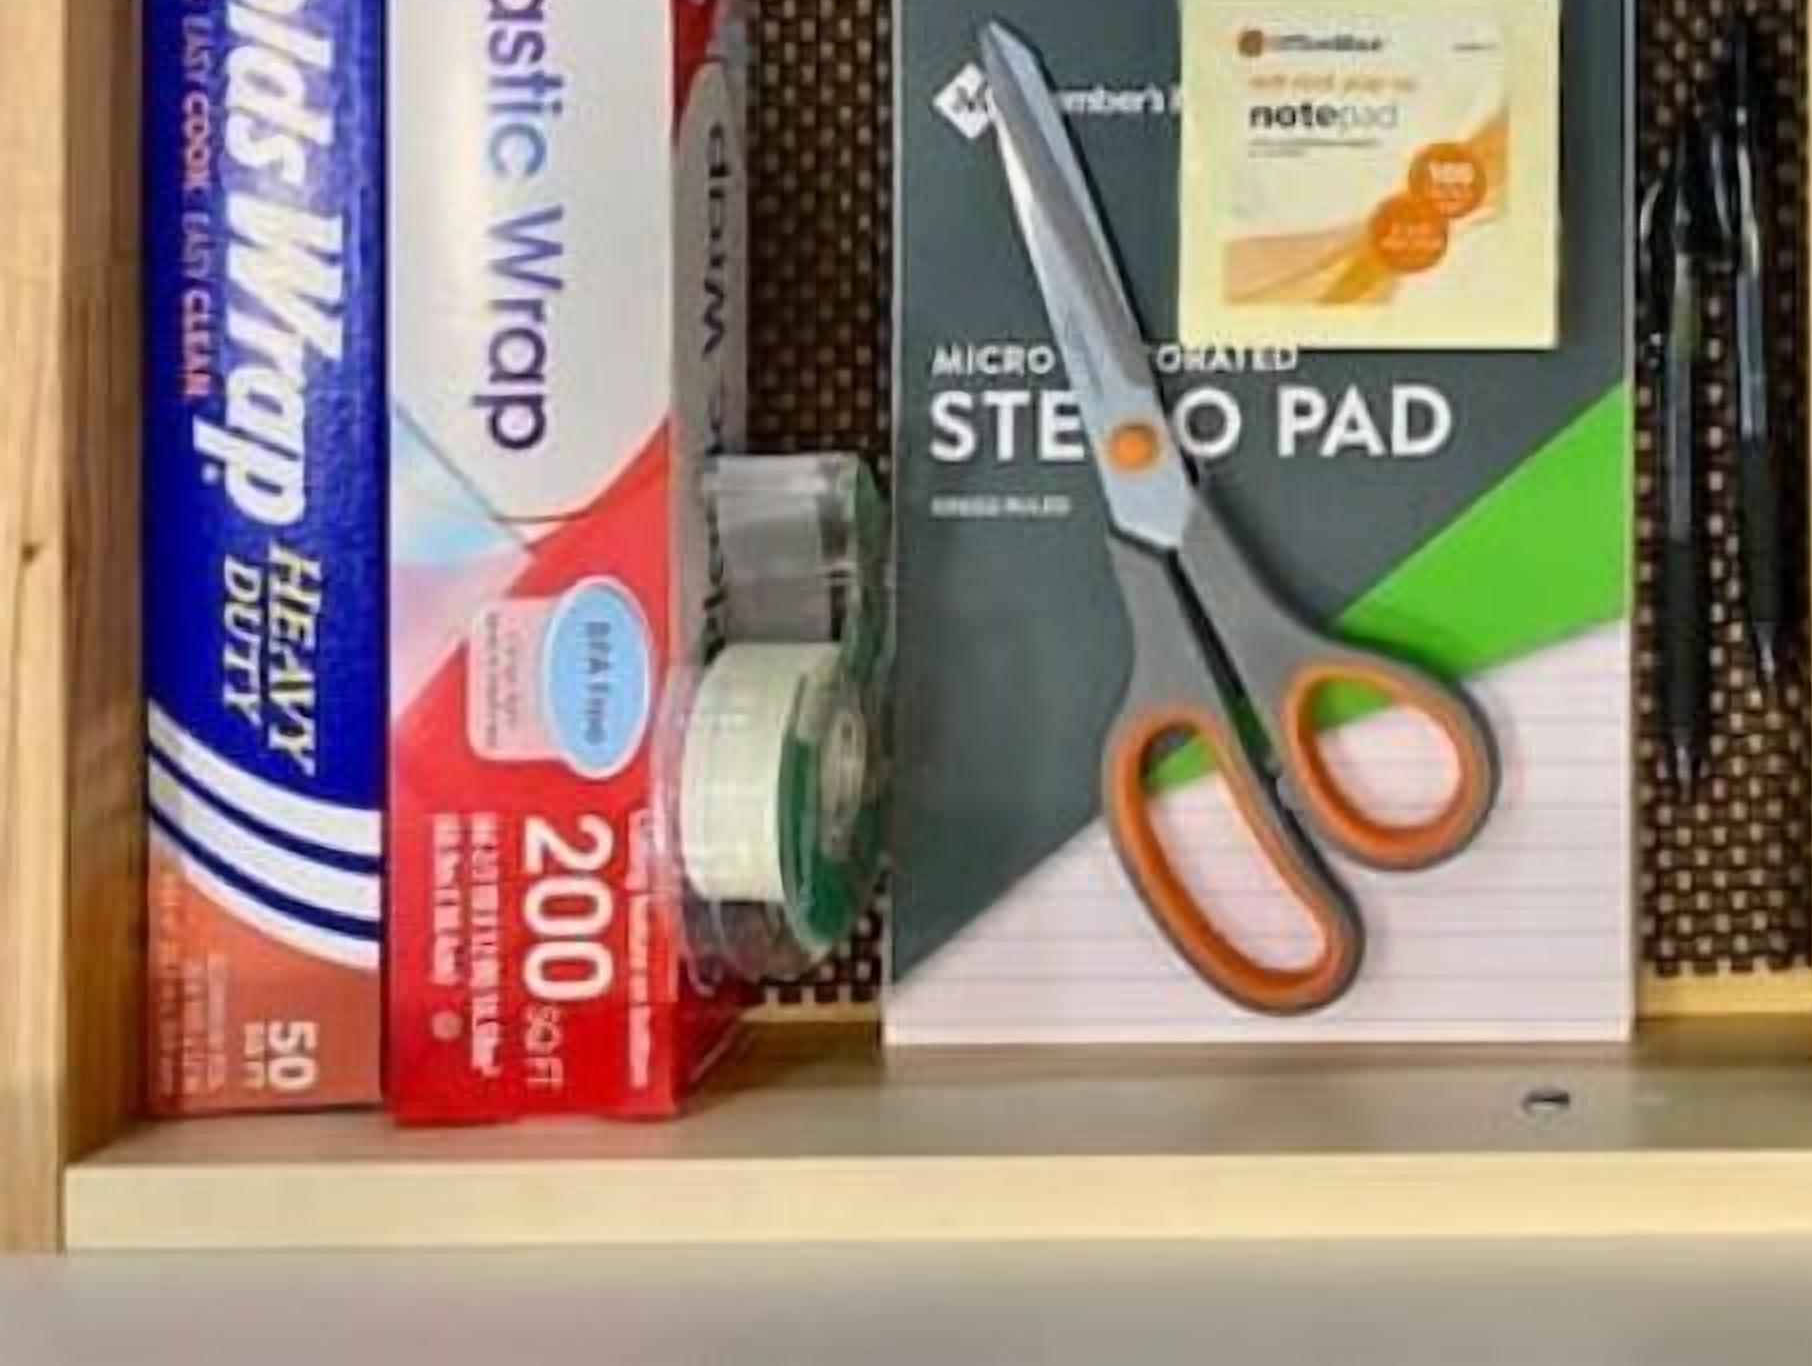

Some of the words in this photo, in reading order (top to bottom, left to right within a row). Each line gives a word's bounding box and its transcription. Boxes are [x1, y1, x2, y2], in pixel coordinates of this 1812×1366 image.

[193, 191, 343, 525] Wrap
[471, 205, 564, 451] Wrap
[930, 345, 1056, 375] MICRO
[1156, 342, 1298, 372] ORATED
[929, 387, 1242, 462] STEO
[1278, 383, 1452, 458] PAD
[224, 554, 262, 728] DUTY
[268, 538, 321, 777] HEAVY
[522, 814, 614, 1001] 200
[267, 1020, 317, 1091] 50
